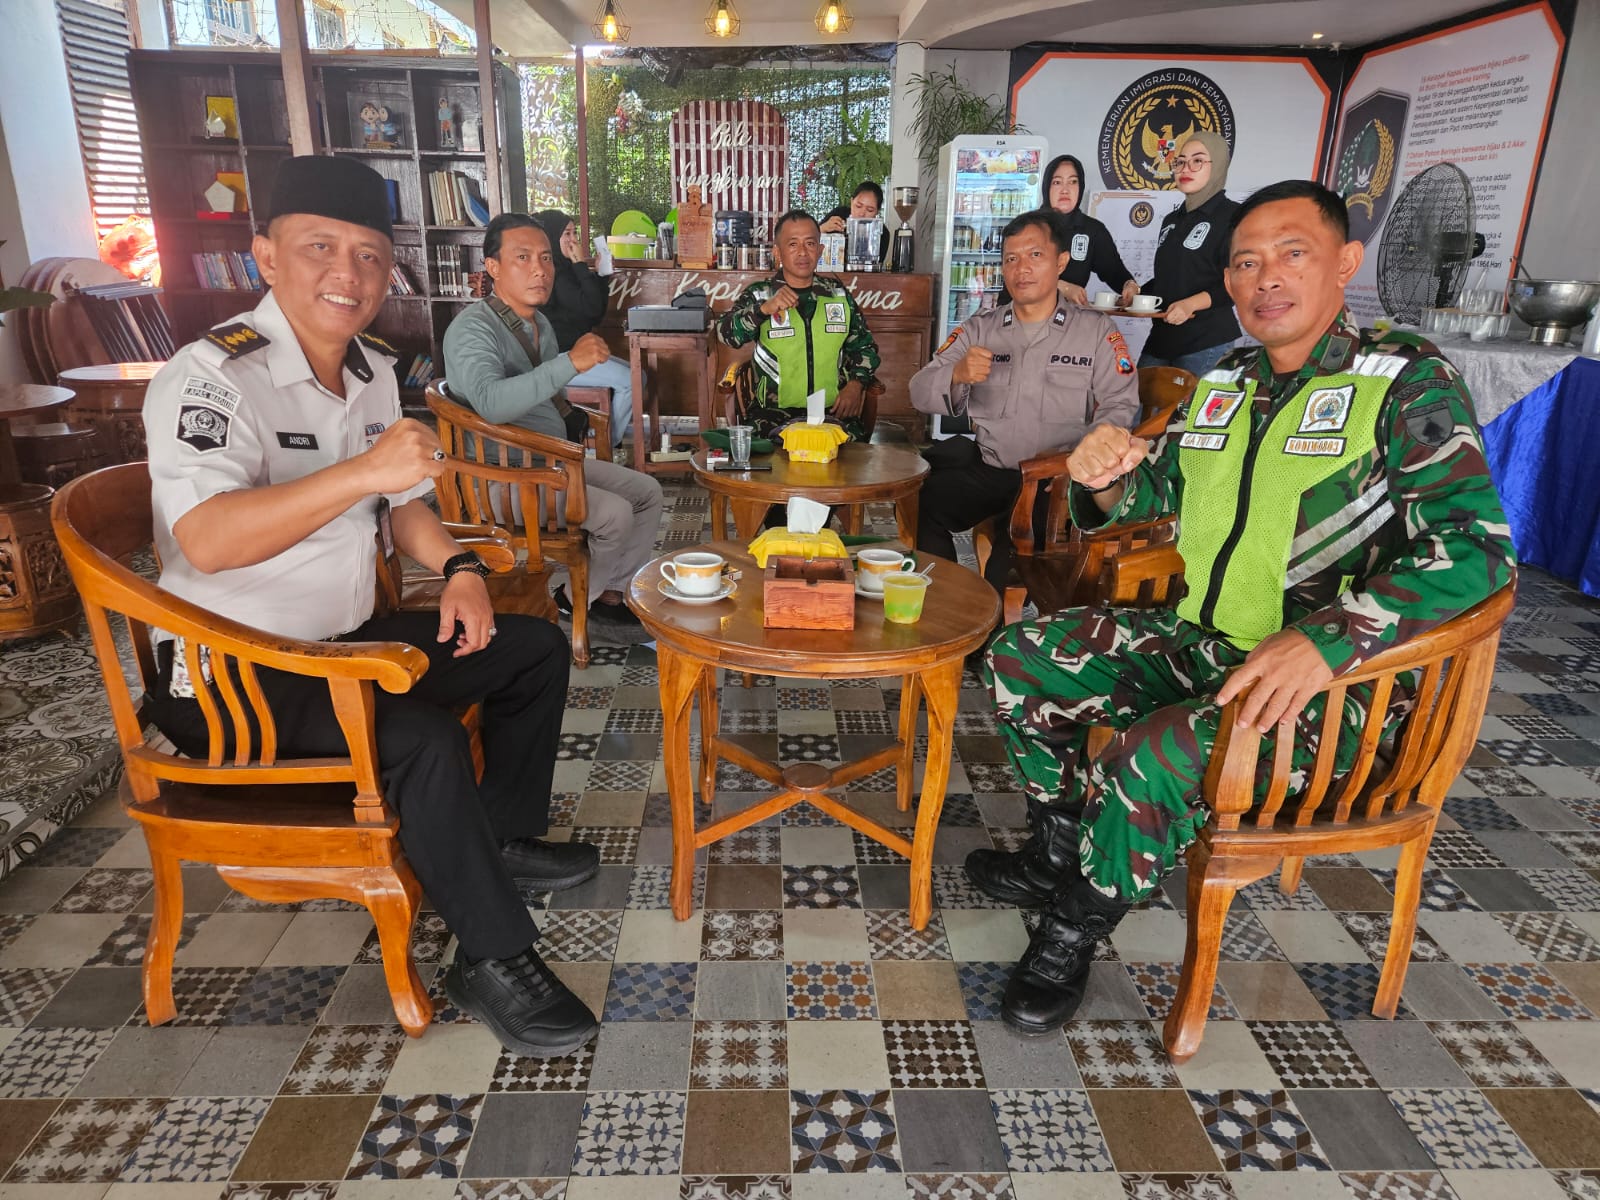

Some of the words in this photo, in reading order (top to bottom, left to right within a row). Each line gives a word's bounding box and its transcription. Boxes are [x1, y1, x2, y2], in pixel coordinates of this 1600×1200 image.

[1102, 96, 1130, 174] KEMENTERIAN
[1130, 73, 1175, 97] IMIGRASI
[1178, 73, 1200, 86] DAN
[1201, 81, 1232, 146] PEMASYARAK
[1051, 354, 1093, 367] POLRI
[289, 436, 310, 447] ANDRI
